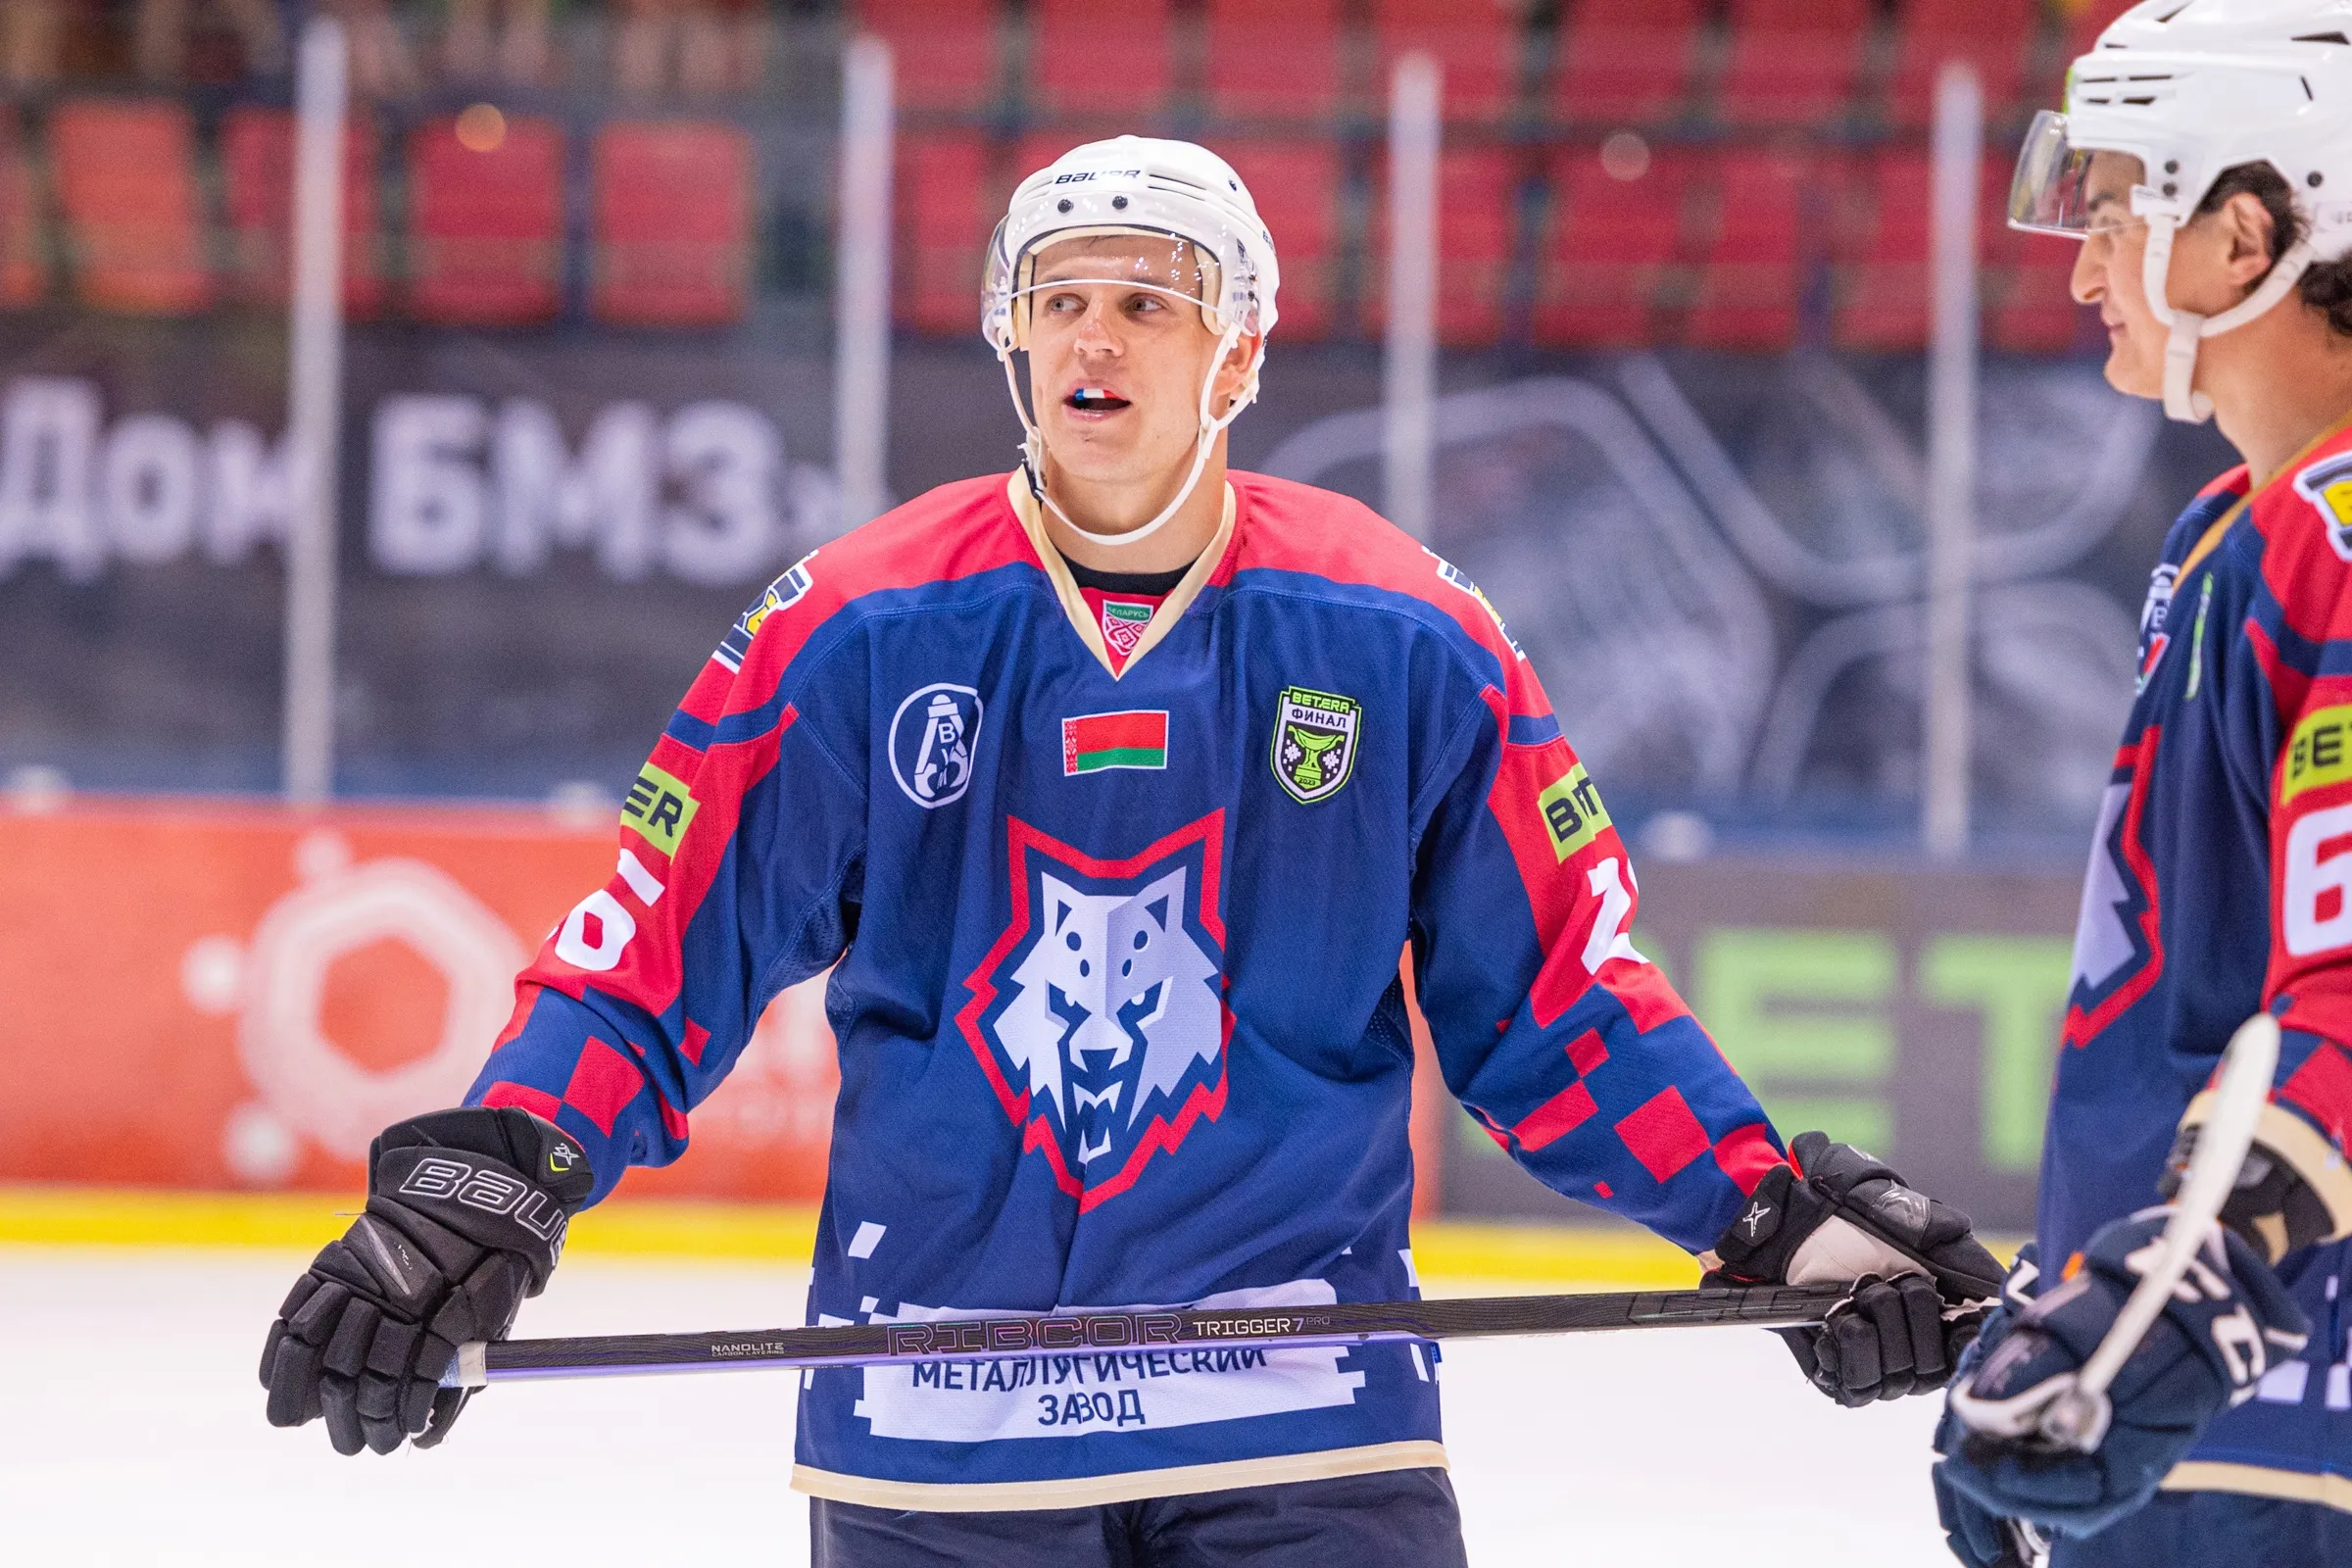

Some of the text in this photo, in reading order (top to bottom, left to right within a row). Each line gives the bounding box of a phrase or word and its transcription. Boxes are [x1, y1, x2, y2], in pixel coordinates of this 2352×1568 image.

[1292, 708, 1347, 728] ФИНАЛ
[711, 1343, 784, 1353] NANOLITE
[887, 1313, 1182, 1356] RIBCOR
[1037, 1388, 1146, 1427] ЗАВОД
